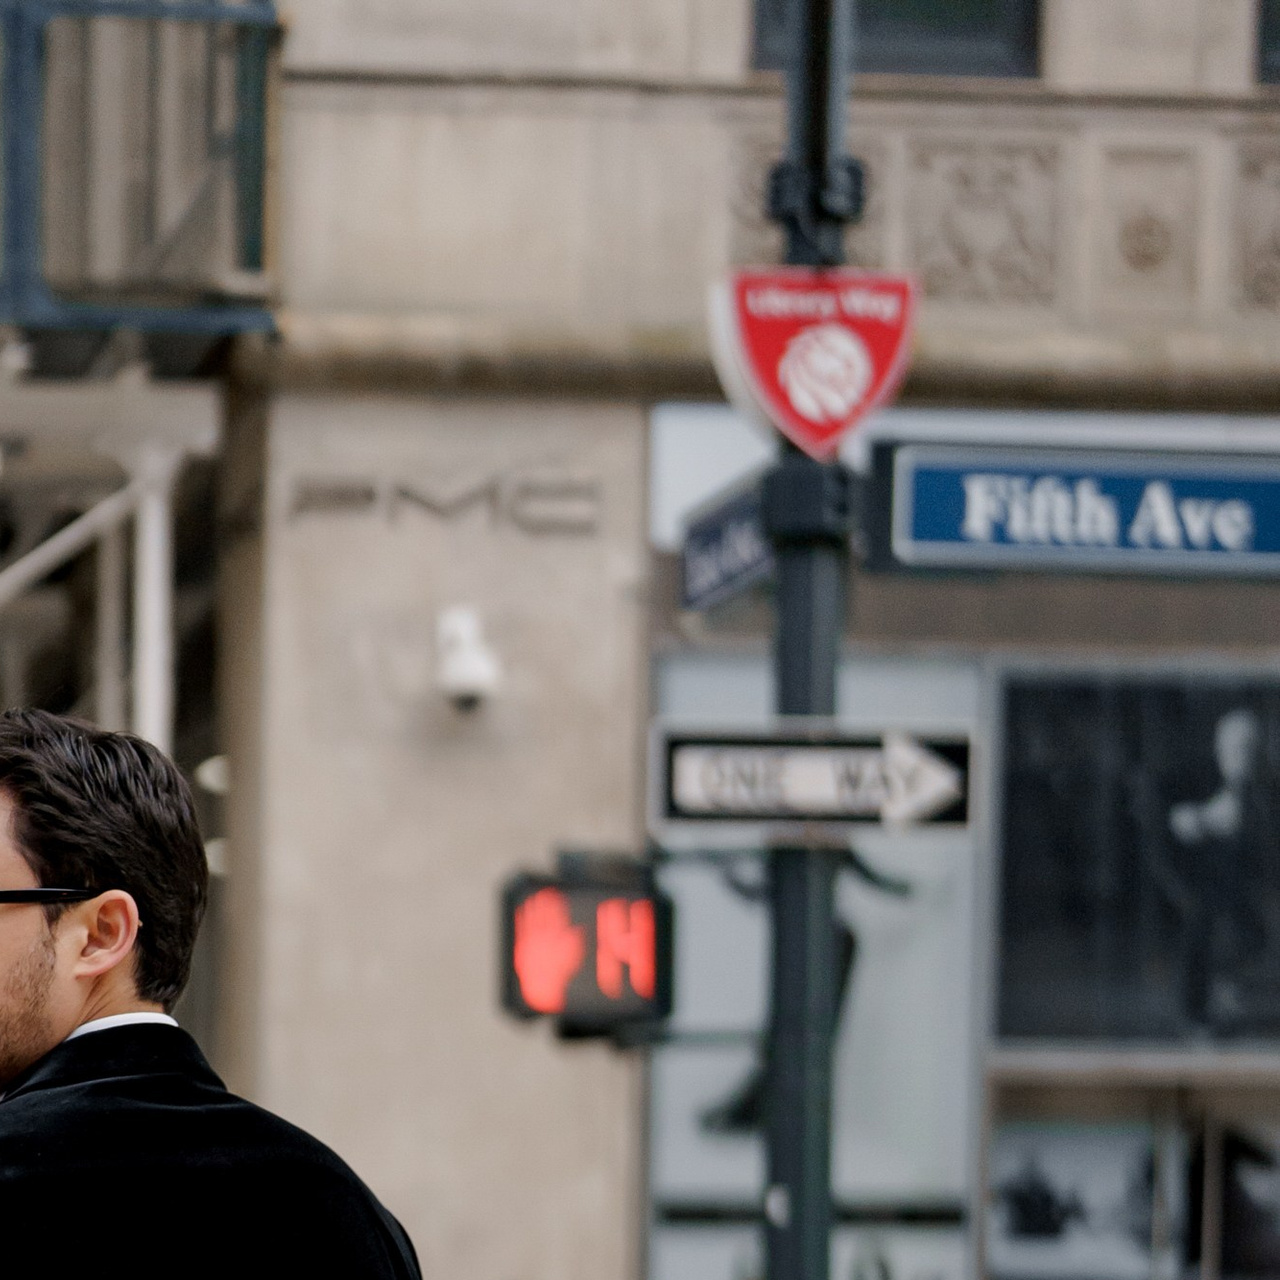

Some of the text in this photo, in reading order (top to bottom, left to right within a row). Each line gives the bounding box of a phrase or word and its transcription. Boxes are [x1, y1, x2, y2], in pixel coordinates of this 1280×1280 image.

[839, 288, 903, 323] Way
[961, 474, 1254, 551] Fifth Ave
[697, 750, 924, 808] ONE WAY
